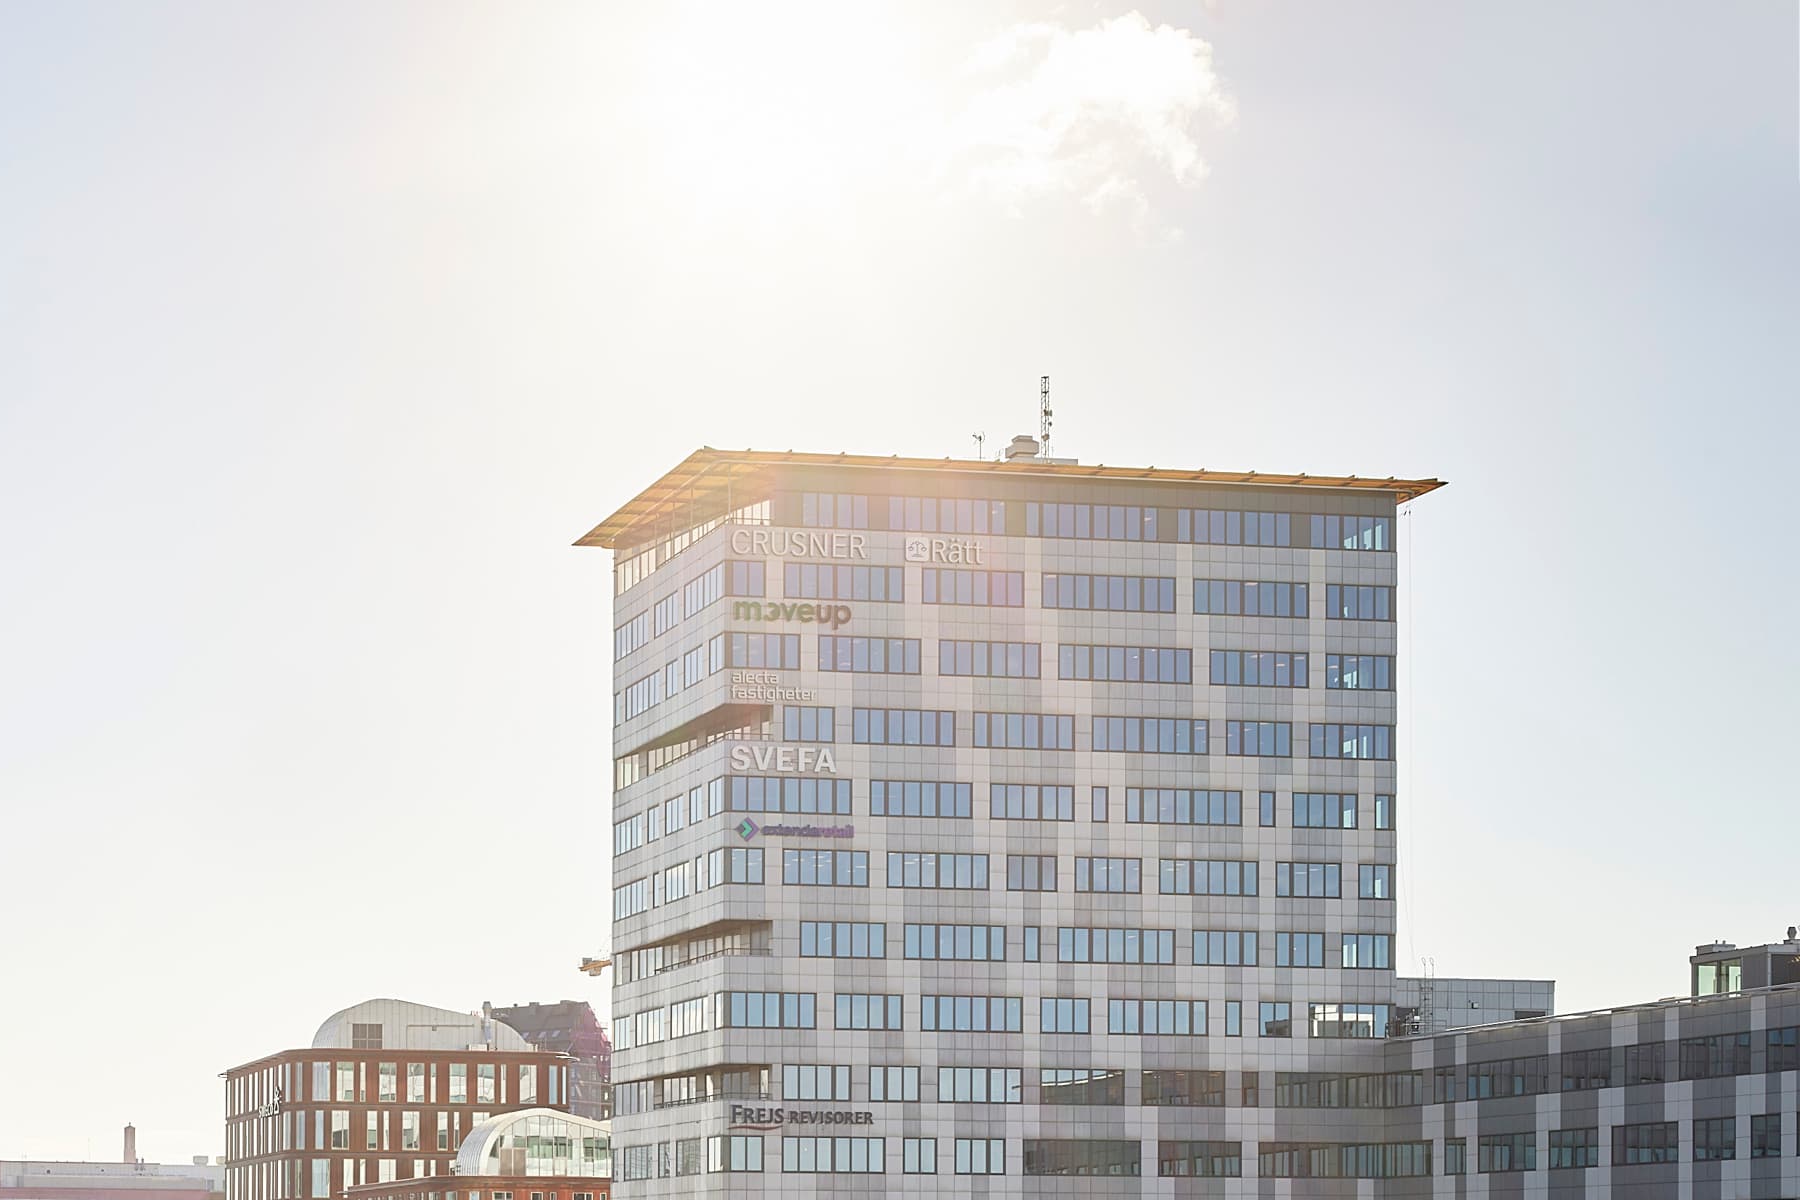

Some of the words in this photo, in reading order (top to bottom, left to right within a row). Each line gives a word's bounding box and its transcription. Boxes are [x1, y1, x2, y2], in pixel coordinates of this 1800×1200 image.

[731, 529, 868, 559] CRUSNER
[931, 537, 984, 565] Rätt
[734, 600, 852, 630] moveup
[731, 671, 779, 684] alecta
[731, 685, 817, 702] fastigheter
[730, 745, 837, 773] SVEFA
[730, 1104, 784, 1124] FREJS
[790, 1111, 873, 1125] REVISORER
